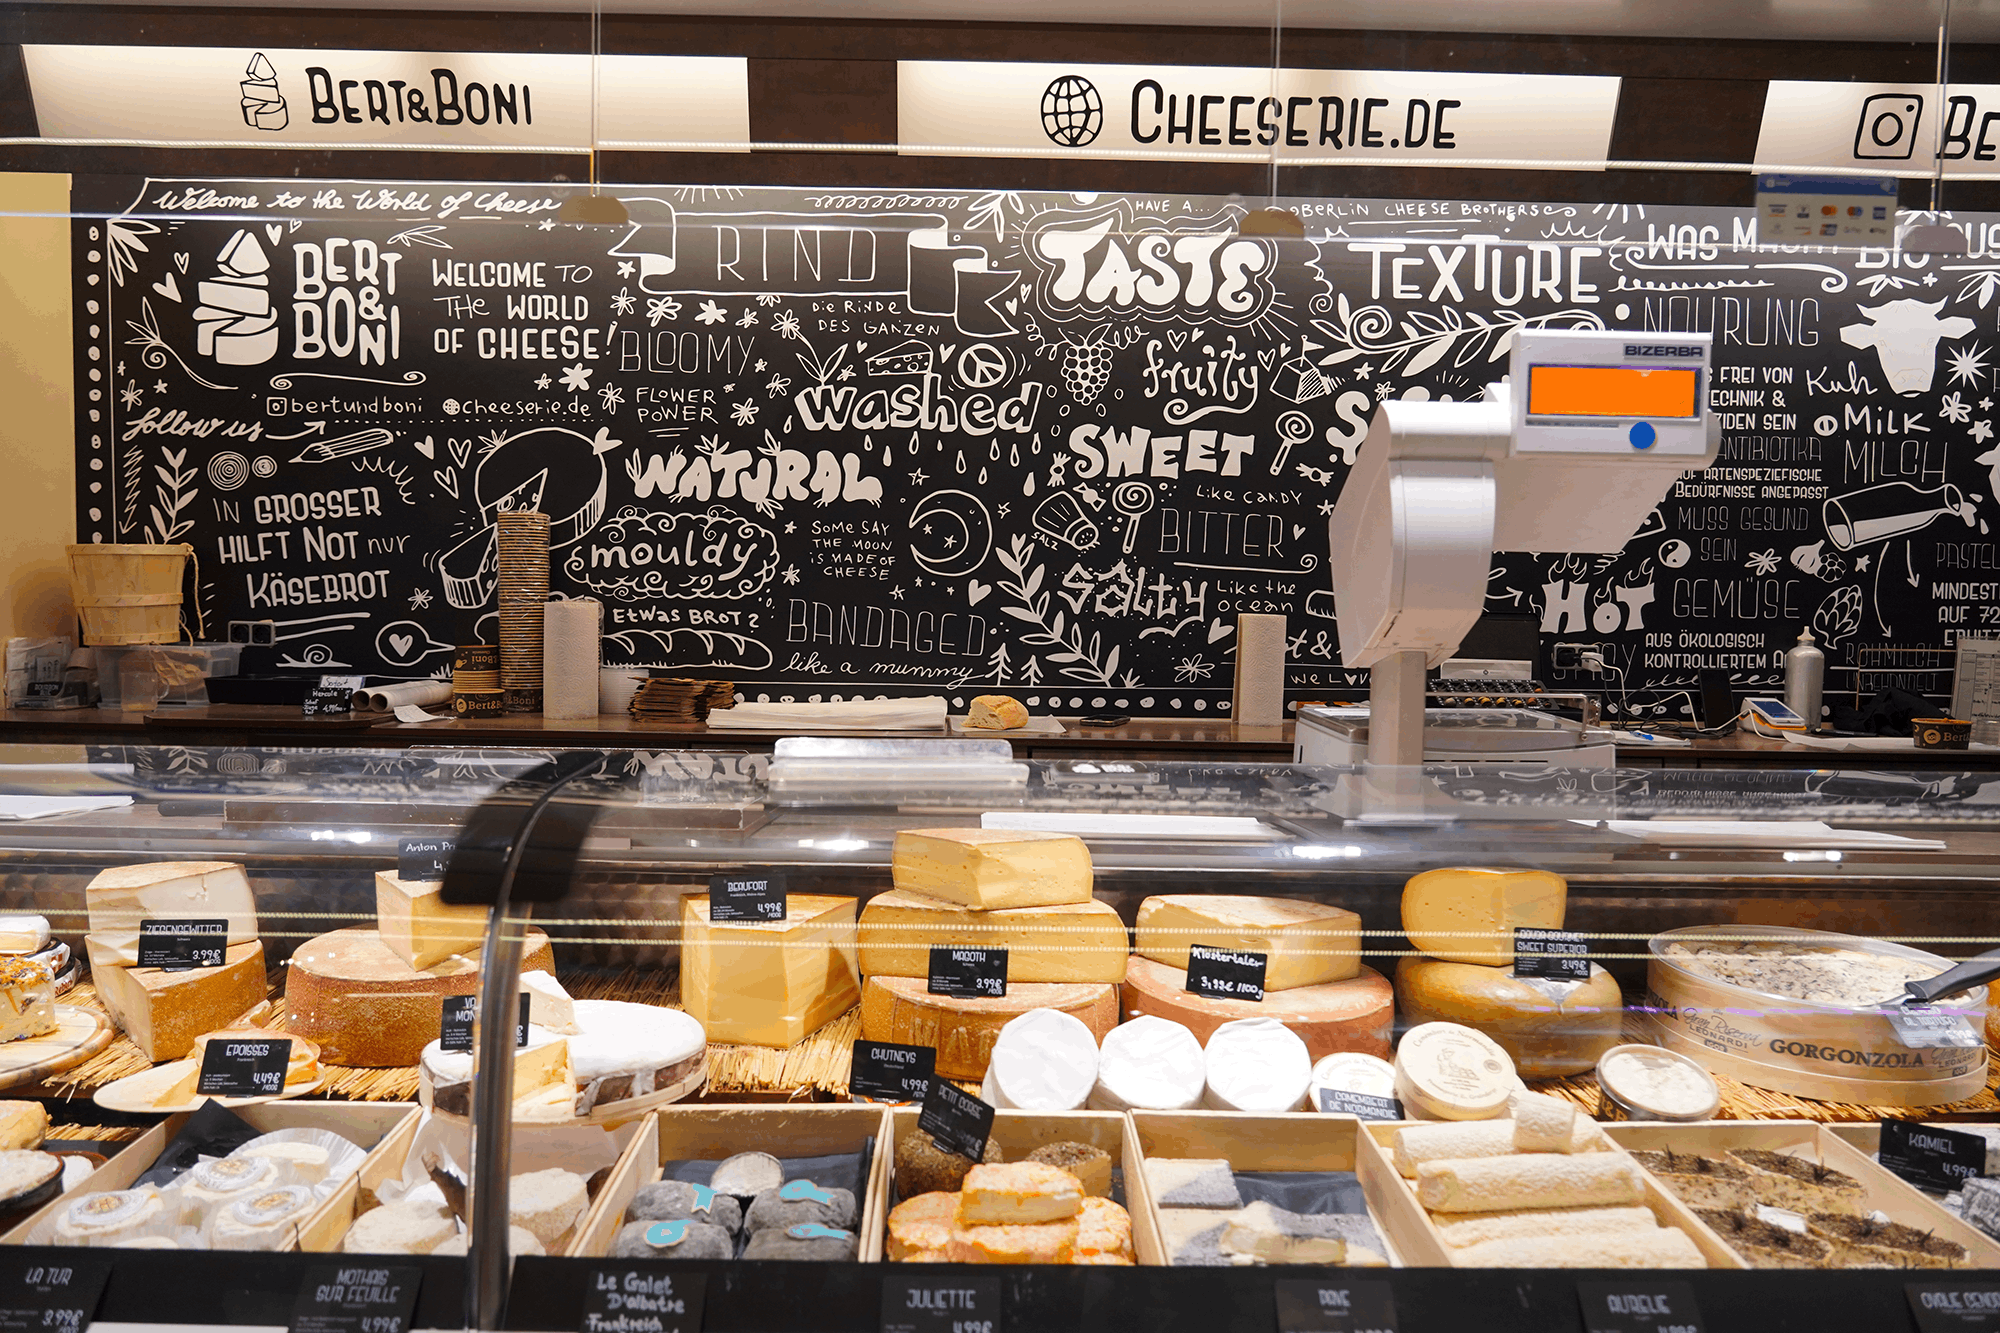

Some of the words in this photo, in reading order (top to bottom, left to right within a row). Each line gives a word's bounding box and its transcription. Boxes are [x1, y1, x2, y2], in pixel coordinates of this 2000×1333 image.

[305, 67, 532, 126] BERT&BONI
[1131, 79, 1461, 149] CHEESERIE.DE
[152, 188, 259, 211] Welcome
[267, 191, 305, 210] to
[312, 188, 346, 211] the
[351, 188, 432, 212] World
[433, 191, 472, 219] of
[1135, 200, 1170, 212] HAVE
[1384, 202, 1450, 217] CHEESE
[1461, 203, 1540, 219] BROTHERS
[1648, 223, 1719, 260] WAS
[711, 225, 878, 281] RIND
[293, 238, 402, 299] BERT
[432, 258, 546, 288] WELCOME
[555, 265, 593, 283] TO
[1040, 217, 1265, 312] TASTE
[1347, 234, 1602, 306] TEXTURE
[359, 286, 387, 321] &
[507, 295, 589, 322] WORLD
[293, 286, 399, 366] BONI
[818, 319, 850, 332] DES
[434, 327, 465, 354] OF
[619, 330, 756, 376] BLOOMY
[1625, 345, 1703, 357] BIZERBA
[1143, 336, 1259, 412] fruity
[1720, 367, 1755, 384] FREI
[1762, 366, 1794, 384] VON
[1805, 361, 1878, 396] Kuh
[292, 396, 423, 413] bertundboni
[462, 395, 591, 416] cheeserie.de
[637, 387, 717, 404] FLOWER
[795, 373, 1043, 433] washed
[1772, 390, 1786, 408] &
[122, 407, 225, 441] follow
[222, 420, 264, 442] us
[1763, 413, 1797, 431] SEIN
[1069, 423, 1255, 479] SWEET
[1844, 439, 1949, 484] MILCH
[631, 448, 883, 503] NATURAL
[1703, 467, 1822, 482] ARTENSPEZIEFISCHE
[1197, 484, 1235, 500] Like
[1674, 480, 1756, 499] BEDÜRFNISSE
[1761, 485, 1829, 499] ANGEPASST
[212, 497, 240, 523] IN
[254, 486, 382, 524] GROSSER
[861, 520, 890, 536] SAY
[1678, 506, 1729, 530] MUSS
[1740, 506, 1809, 531] GESUND
[1030, 531, 1059, 551] SALZ
[1158, 508, 1284, 558] BITTER
[218, 531, 292, 564] HILFT
[303, 525, 359, 562] NOT
[367, 535, 410, 554] nur
[812, 538, 842, 549] THE
[851, 539, 893, 551] MOON
[1700, 537, 1737, 561] SEIN
[591, 530, 757, 581] mouldy
[831, 553, 877, 565] MADE
[880, 556, 896, 566] OF
[823, 566, 890, 581] CHEESE
[247, 569, 390, 609] KÄSEBROT
[1264, 579, 1297, 597] the
[1673, 577, 1801, 619] GEMÜSE
[1932, 581, 2000, 600] MINDEST
[1217, 600, 1294, 613] ocean
[1938, 605, 1971, 623] AUF
[786, 598, 987, 657] BANDAGED
[1645, 632, 1672, 648] AUS
[1679, 629, 1765, 648] ÖKOLOGISCH
[1644, 653, 1766, 669] KONTROLLIERTEM
[1773, 650, 1787, 668] A
[1845, 642, 1941, 667] ROHMILCH
[780, 651, 832, 676] like
[838, 660, 860, 676] a
[868, 657, 988, 691] mummy
[405, 842, 437, 852] Anton
[727, 880, 768, 892] BEAUFORT
[757, 902, 782, 913] 4.99€
[146, 924, 223, 935] ZIEGENGEWITTER
[192, 950, 221, 960] 3.99€
[952, 950, 986, 962] MAGOTH
[1516, 941, 1545, 952] SWEET
[1547, 942, 1588, 955] SUPERIOR
[1561, 960, 1587, 970] 3.49€
[976, 978, 1003, 989] 3.99€
[1690, 1023, 1748, 1049] LEONARDI
[226, 1044, 270, 1057] EPOISSES
[870, 1047, 917, 1064] CHUTNEYS
[1769, 1037, 1924, 1068] GORGONZOLA
[253, 1072, 281, 1084] 4.49€
[901, 1078, 929, 1092] 4.99€
[1908, 1132, 1955, 1154] KAMIEL
[25, 1267, 44, 1284] LA
[46, 1267, 73, 1286] TUR
[596, 1271, 617, 1290] Le
[906, 1289, 976, 1309] JULIETTE
